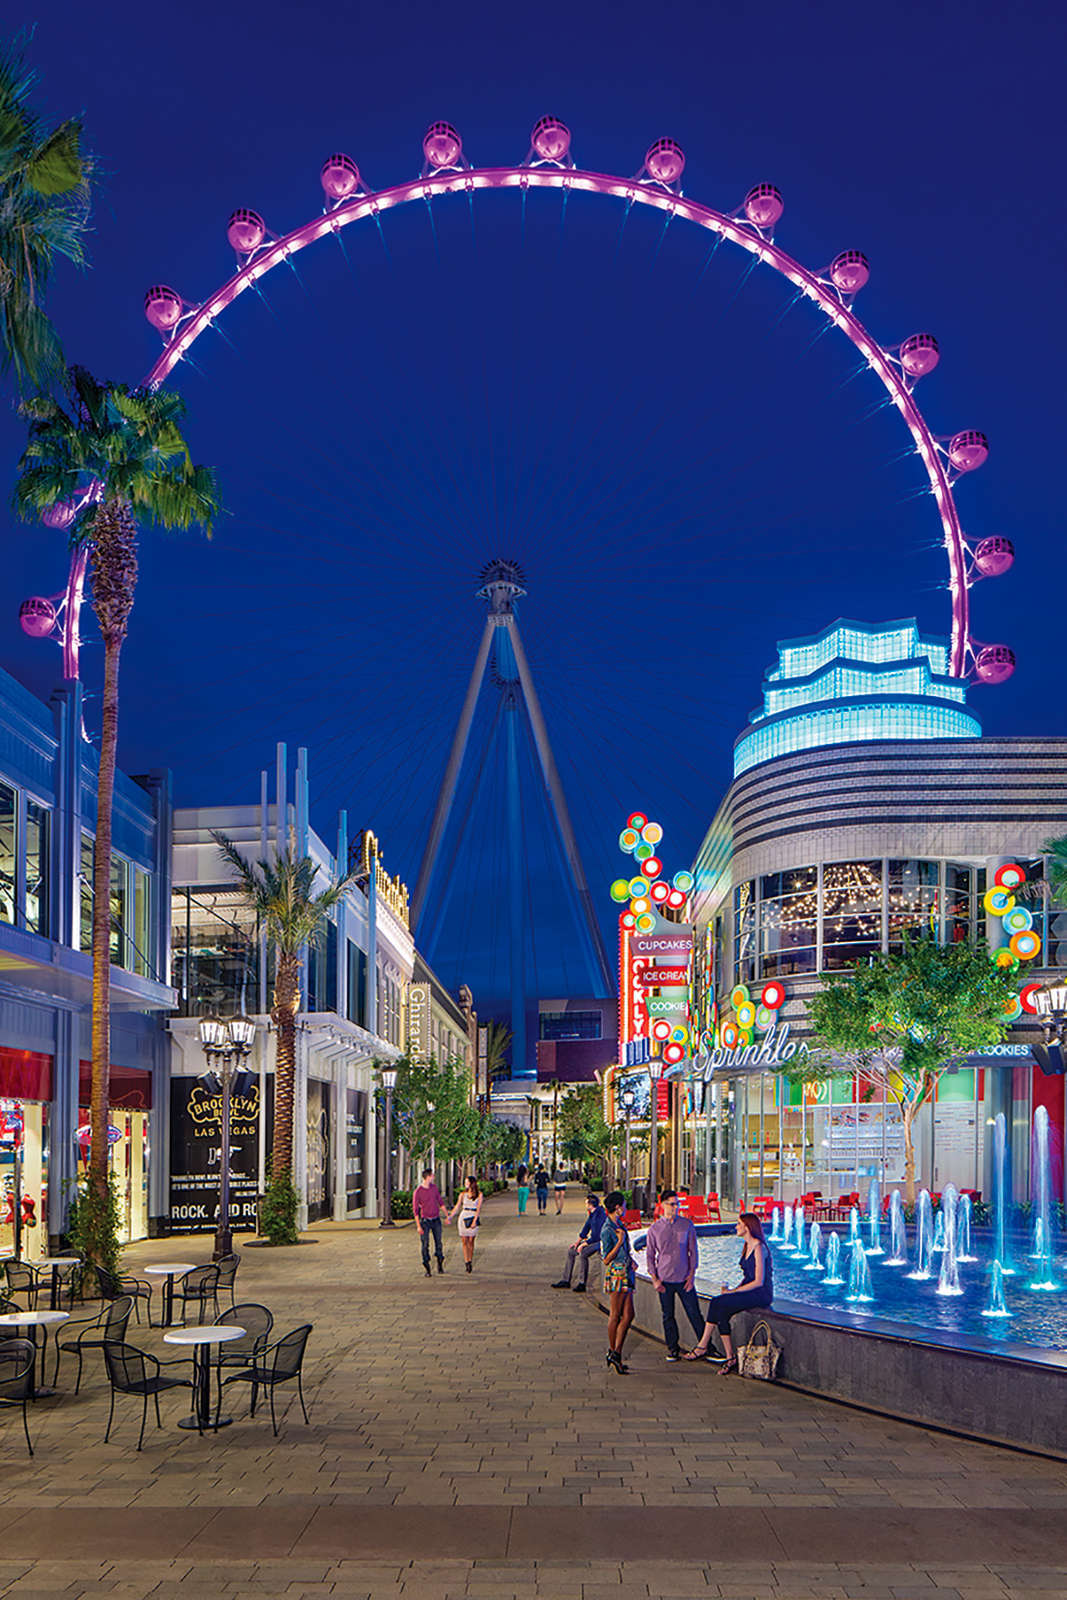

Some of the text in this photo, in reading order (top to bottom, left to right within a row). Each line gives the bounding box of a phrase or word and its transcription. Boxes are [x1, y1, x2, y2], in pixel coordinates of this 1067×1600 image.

[638, 940, 692, 950] CUPCAKES
[643, 971, 658, 981] ICE
[977, 1044, 1029, 1056] COOKIES
[194, 1128, 215, 1137] LAS
[171, 1204, 208, 1220] ROCK.
